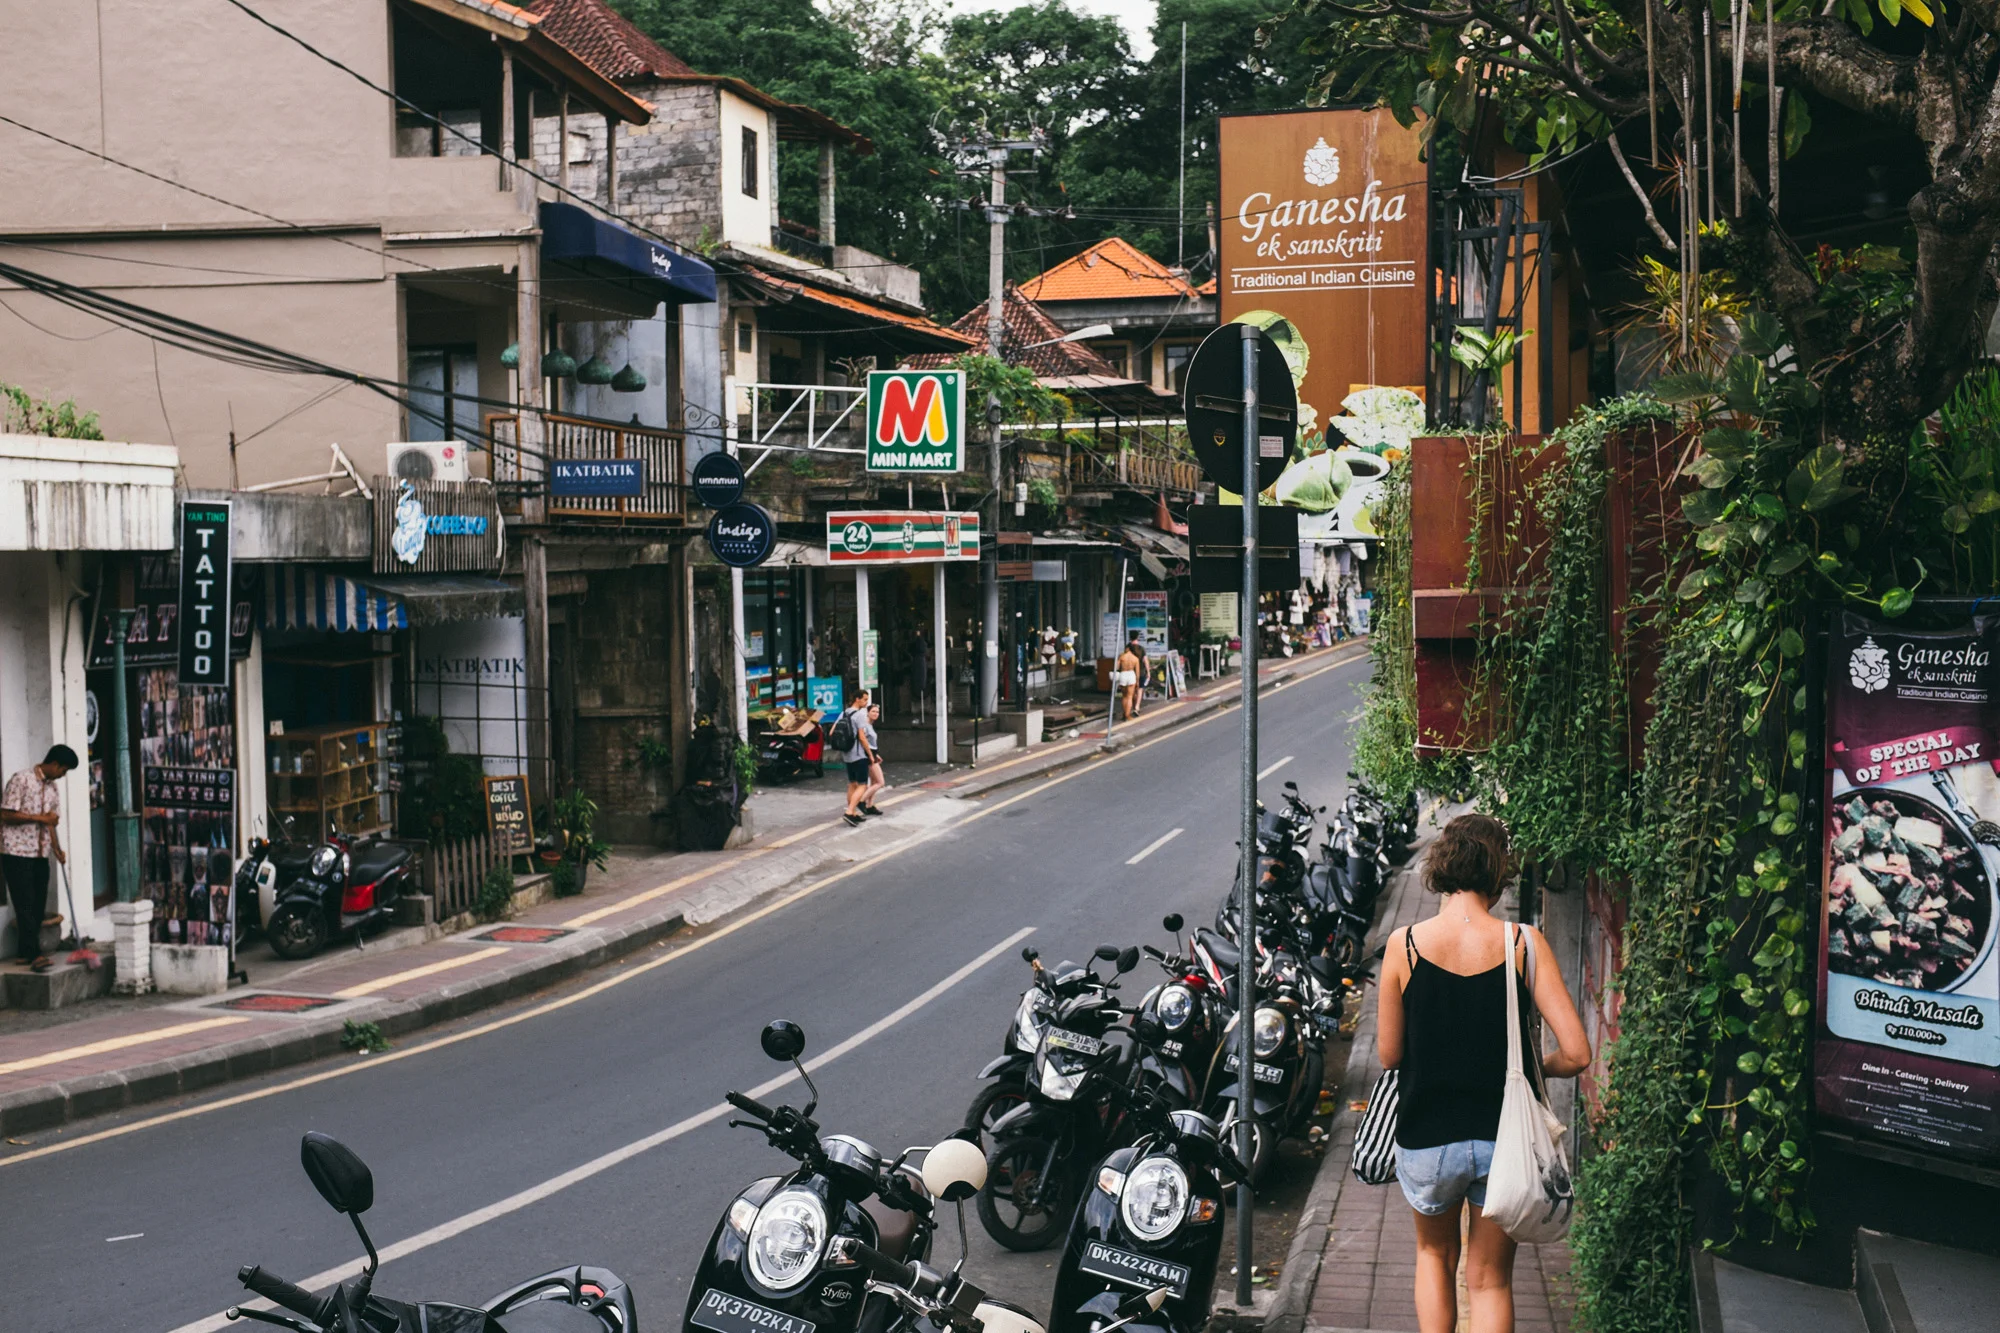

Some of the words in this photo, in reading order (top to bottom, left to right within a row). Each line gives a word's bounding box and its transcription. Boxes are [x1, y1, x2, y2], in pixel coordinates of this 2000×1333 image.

[1238, 180, 1407, 243] Ganesha
[1256, 232, 1287, 261] ek
[1287, 229, 1384, 259] sanskriti
[1231, 271, 1306, 288] Traditional
[1311, 270, 1355, 284] Indian
[1360, 268, 1415, 282] Cuisine
[872, 452, 907, 467] MINI
[909, 452, 953, 467] MART
[556, 464, 635, 478] IKATBATIK
[187, 512, 203, 523] YAN
[205, 512, 226, 523] TINO
[846, 525, 868, 543] 24
[194, 528, 215, 675] TATTOO
[1897, 641, 1990, 671] Ganesha
[1907, 666, 1924, 684] ek
[1923, 668, 1977, 685] sanskriti
[1897, 687, 1933, 697] Traditional
[1935, 690, 1959, 699] Indian
[1960, 691, 1988, 700] Cuisine
[1870, 732, 1953, 763] SPECIAL
[1856, 765, 1882, 783] OF
[1891, 755, 1931, 776] THE
[1937, 742, 1981, 766] DAY
[162, 770, 183, 782] YAN
[187, 771, 216, 784] TINO
[148, 784, 230, 802] TATTOO
[492, 781, 516, 792] BEST
[495, 810, 524, 822] UBUD
[1856, 990, 1911, 1015] Bhindi
[1913, 1002, 1980, 1026] Masala
[1899, 1026, 1943, 1041] 110.000++
[1861, 1062, 1881, 1075] Dine
[1881, 1066, 1890, 1075] In
[1895, 1069, 1929, 1085] Catering
[1934, 1077, 1970, 1093] Delivery
[1091, 1246, 1181, 1283] DK3424KAM
[820, 1286, 852, 1301] Stylish
